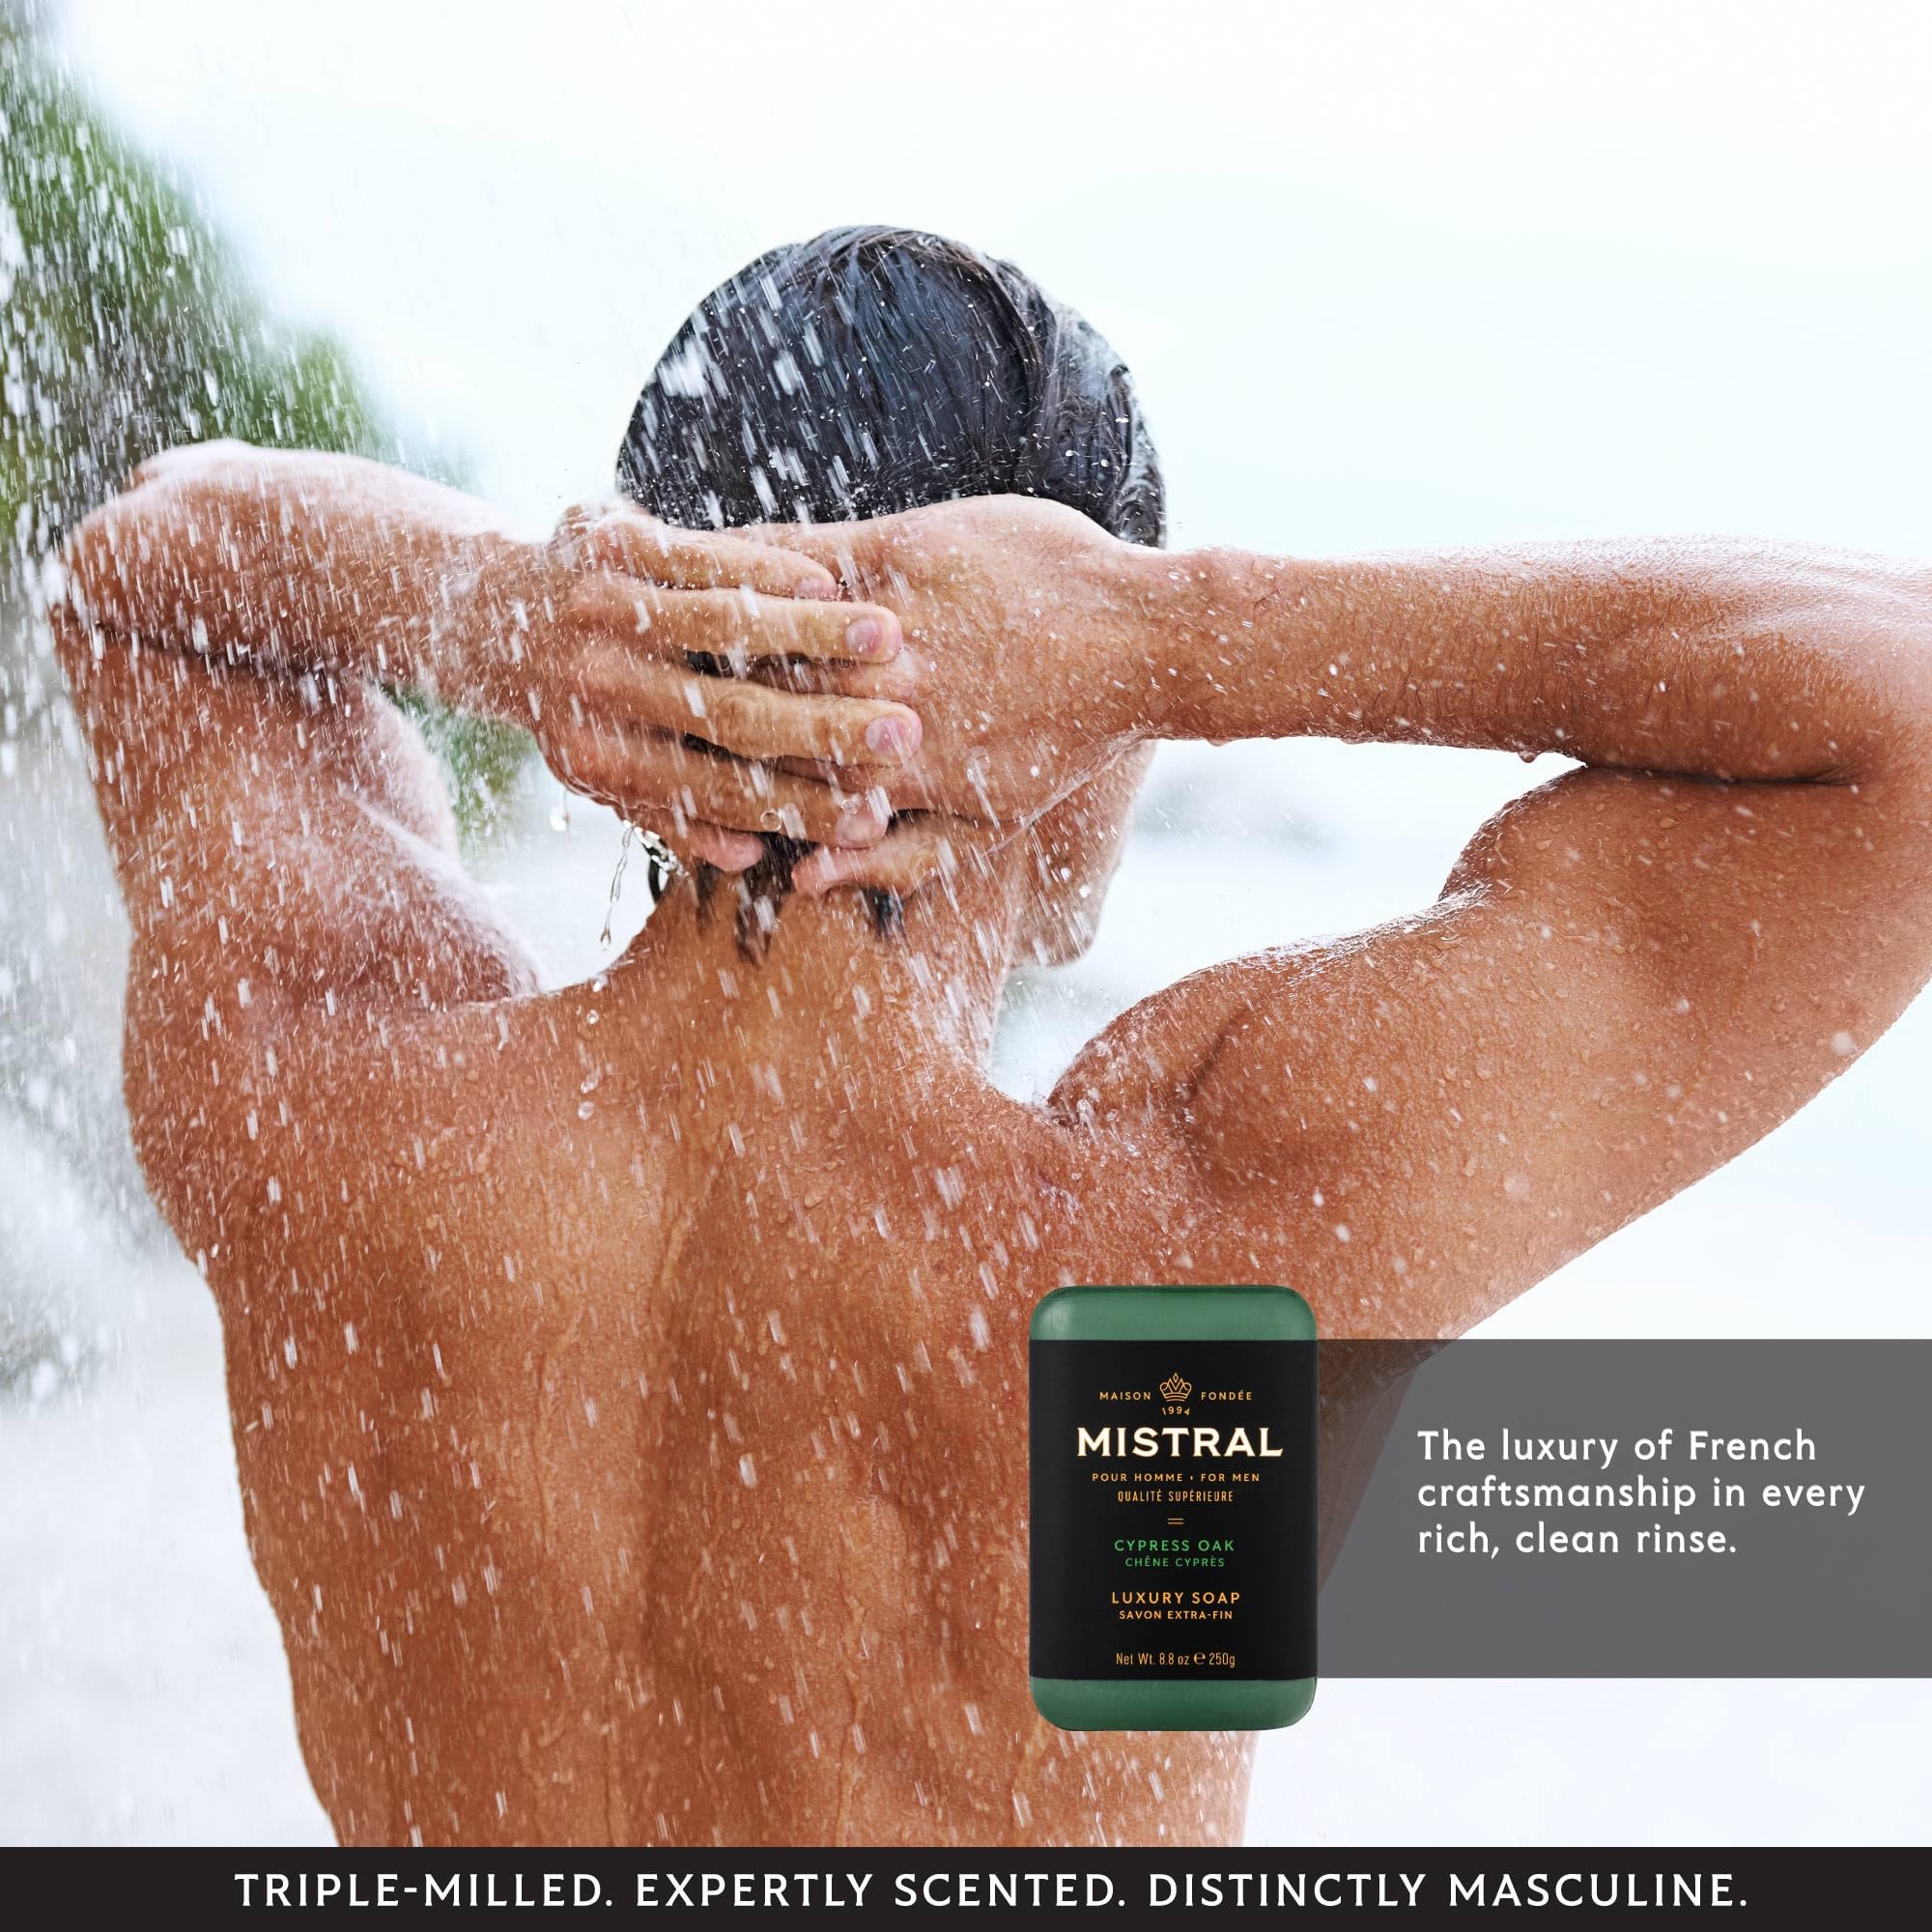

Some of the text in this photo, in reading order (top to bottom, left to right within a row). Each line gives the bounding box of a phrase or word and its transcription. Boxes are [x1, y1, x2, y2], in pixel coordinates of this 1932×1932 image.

[1099, 1389, 1252, 1401] MAISON FONDÉE
[1161, 1406, 1190, 1416] 1994
[1077, 1427, 1284, 1458] MISTRAL
[1092, 1473, 1260, 1482] POUR HOMME FOR MEN
[1118, 1488, 1234, 1503] QUALITÉ SUPÉRIEURE
[1114, 1539, 1235, 1551] CYPRESS OAK
[1124, 1555, 1225, 1567] CHÊNE CYPRÈS
[1112, 1591, 1240, 1605] LUXURY SOAP
[1119, 1610, 1233, 1620] SAVON EXTRA-FIN
[1116, 1653, 1134, 1665] Net
[1138, 1652, 1155, 1665] Wt.
[1159, 1652, 1175, 1665] 8.8
[1178, 1655, 1190, 1665] oz
[1208, 1652, 1236, 1668] 250g
